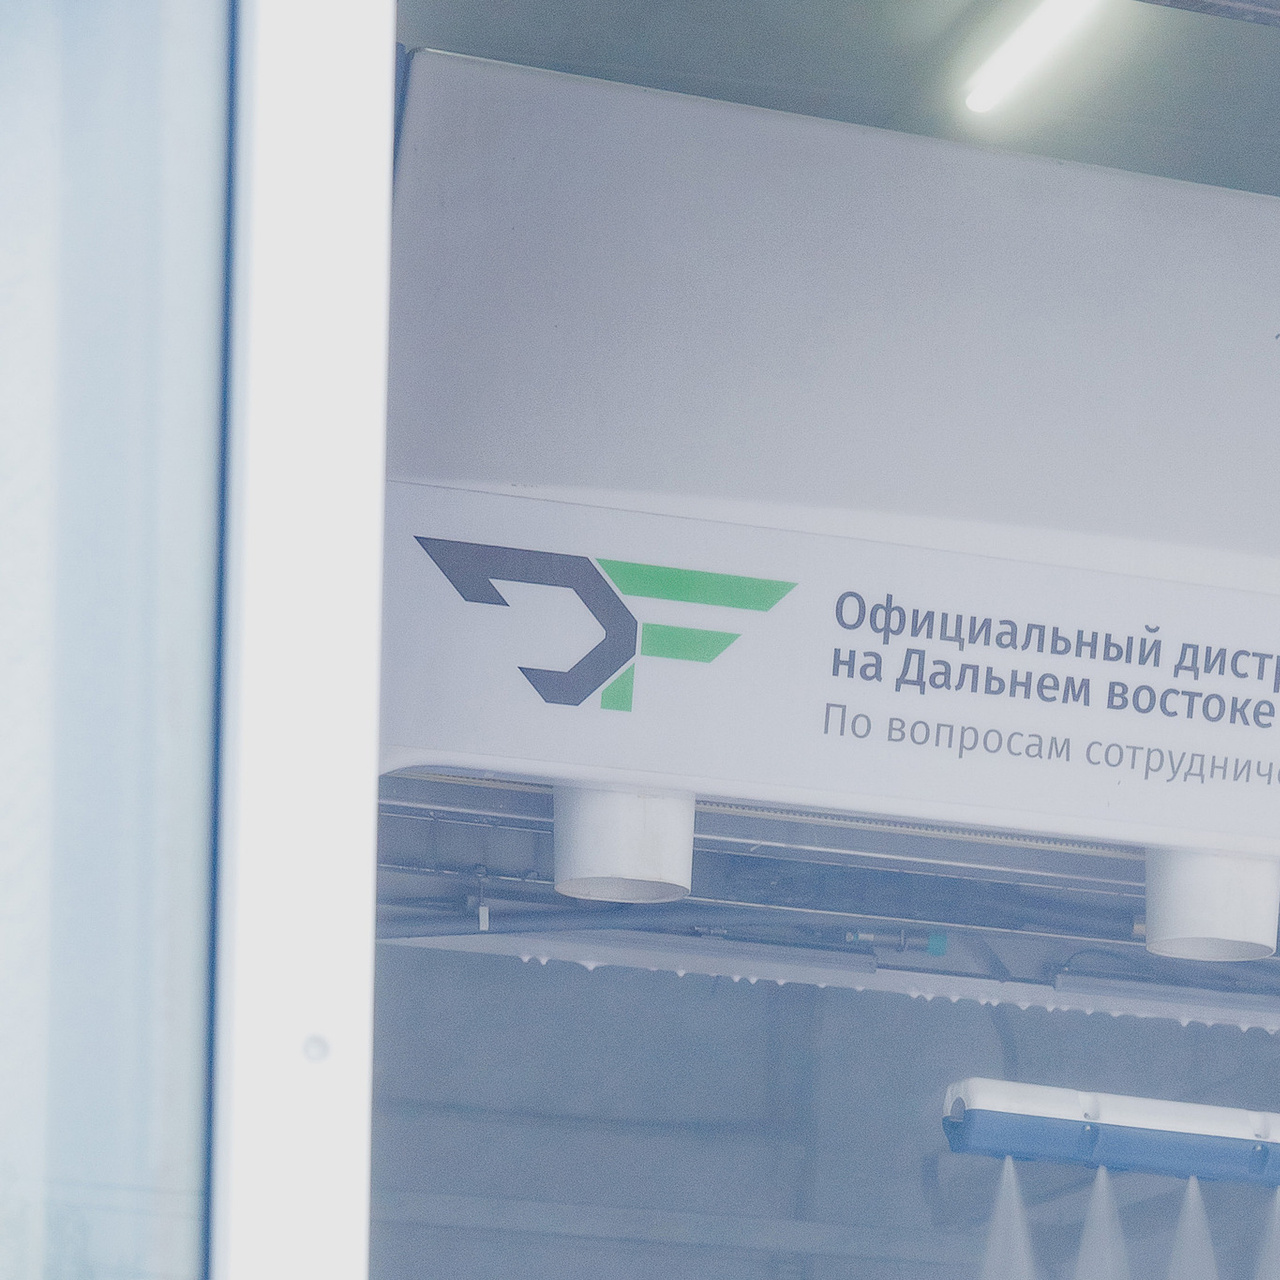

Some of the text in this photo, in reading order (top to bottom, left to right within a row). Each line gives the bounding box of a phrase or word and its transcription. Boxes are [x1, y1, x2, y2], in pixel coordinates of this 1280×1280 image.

[833, 589, 1163, 669] Официальный
[830, 646, 1277, 730] на Дальнем востоке
[822, 701, 873, 740] По
[886, 716, 1073, 762] вопросам
